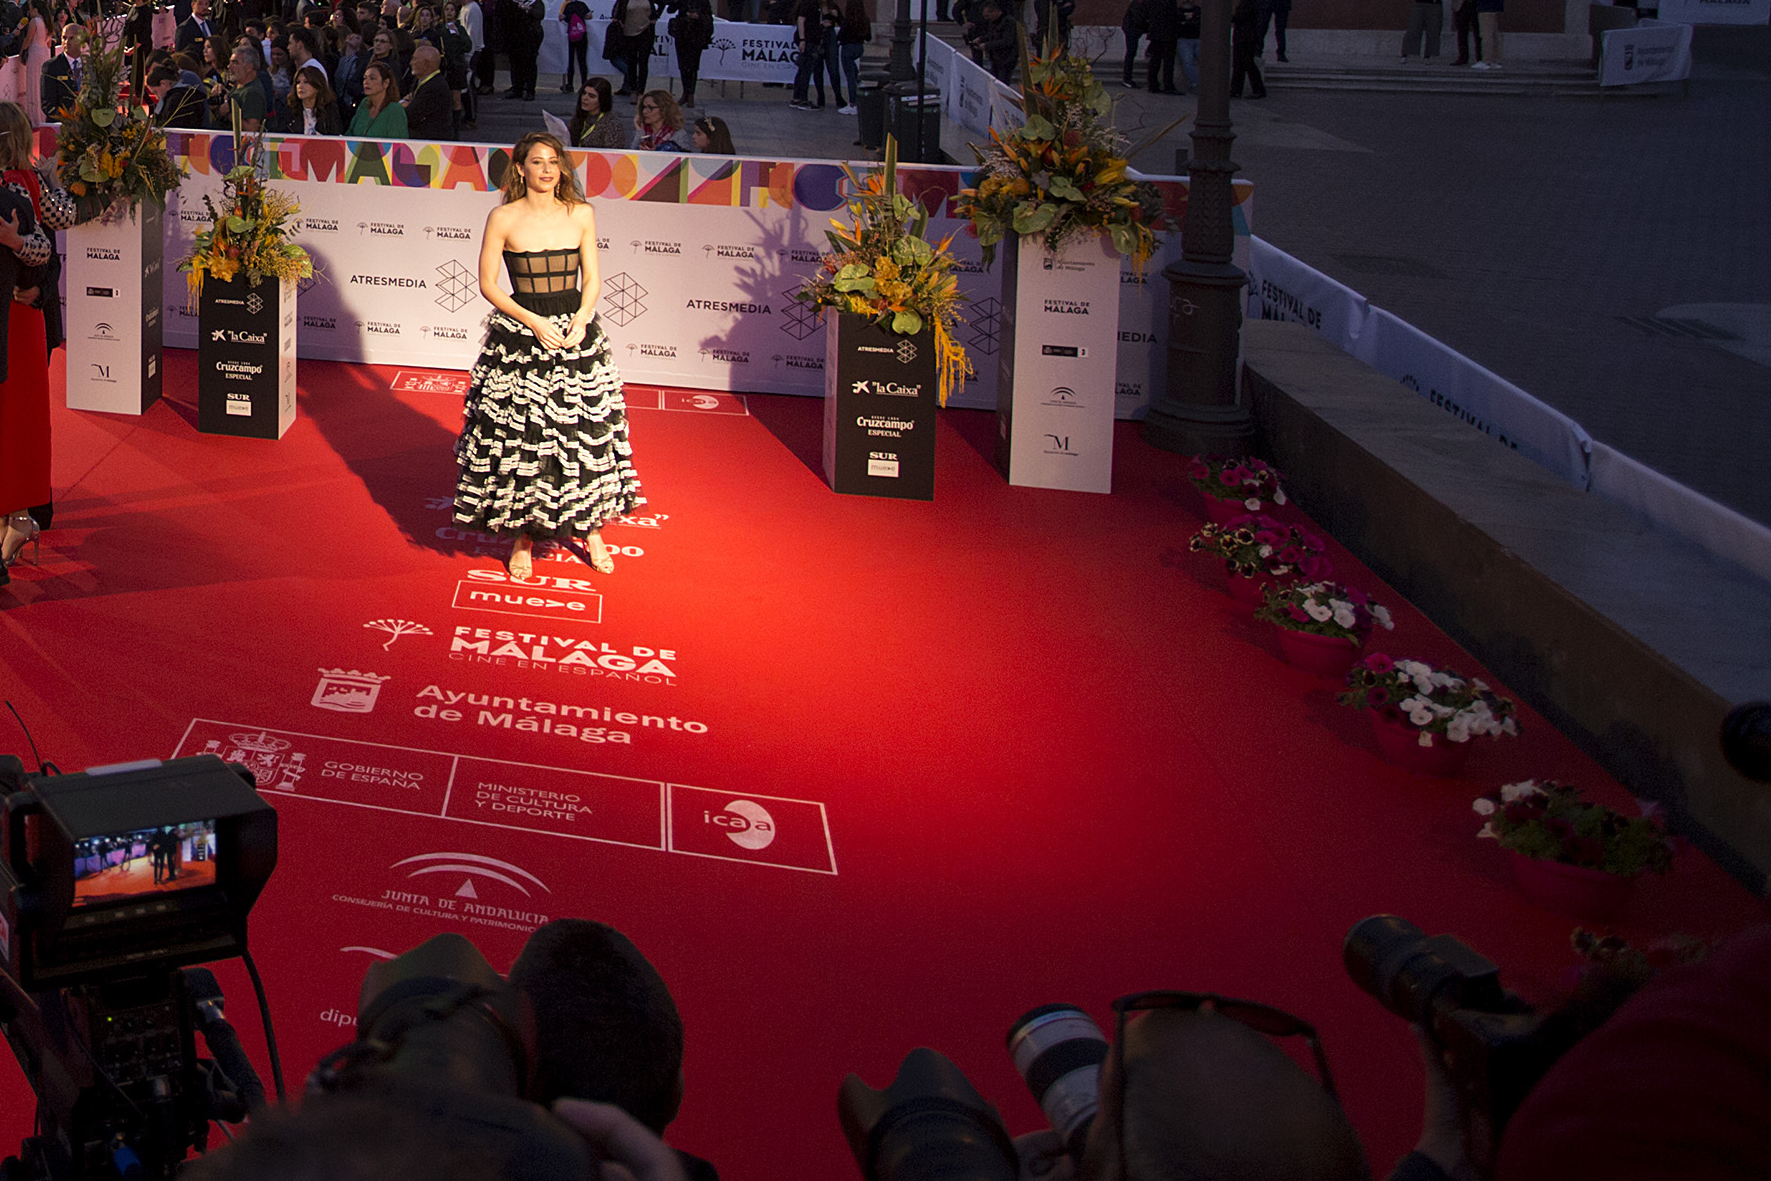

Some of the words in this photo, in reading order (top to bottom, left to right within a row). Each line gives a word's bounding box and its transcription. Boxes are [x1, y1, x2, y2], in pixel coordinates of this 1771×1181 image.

[742, 39, 796, 50] FESTIVAL
[742, 48, 799, 63] MÁLAG
[350, 275, 427, 289] ATRESMEDIA
[686, 299, 771, 315] ATRESMEDIA
[1261, 279, 1304, 320] FESTIVAL
[1308, 307, 1322, 330] DE
[857, 346, 895, 354] ATRESMEDIA
[216, 361, 263, 374] Cruzcampo
[227, 393, 250, 401] SUR
[856, 415, 915, 431] Cruzcampo
[868, 429, 901, 438] ESPECIAL
[869, 451, 898, 460] SUR
[467, 570, 597, 592] SUR
[455, 626, 617, 653] FESTIVAL
[633, 646, 677, 661] DE
[450, 637, 677, 678] MÁLAGA
[448, 653, 507, 666] CINE
[518, 659, 547, 670] EN
[558, 664, 677, 686] ESPAÑOL
[416, 684, 708, 735] Ayuntamiento
[414, 705, 463, 721] de
[478, 710, 632, 744] Málaga
[321, 768, 347, 779] DE
[350, 770, 421, 791] ESPAÑA
[324, 761, 424, 782] GOBIERNO
[476, 791, 502, 802] DE
[506, 793, 593, 815] CULTURA
[478, 782, 581, 803] MINISTERIO
[475, 799, 486, 808] Y
[482, 801, 576, 822] DEPORTE
[380, 889, 430, 906] JUNTA
[438, 898, 457, 911] DE
[395, 905, 411, 913] DE
[413, 907, 461, 921] CULTURA
